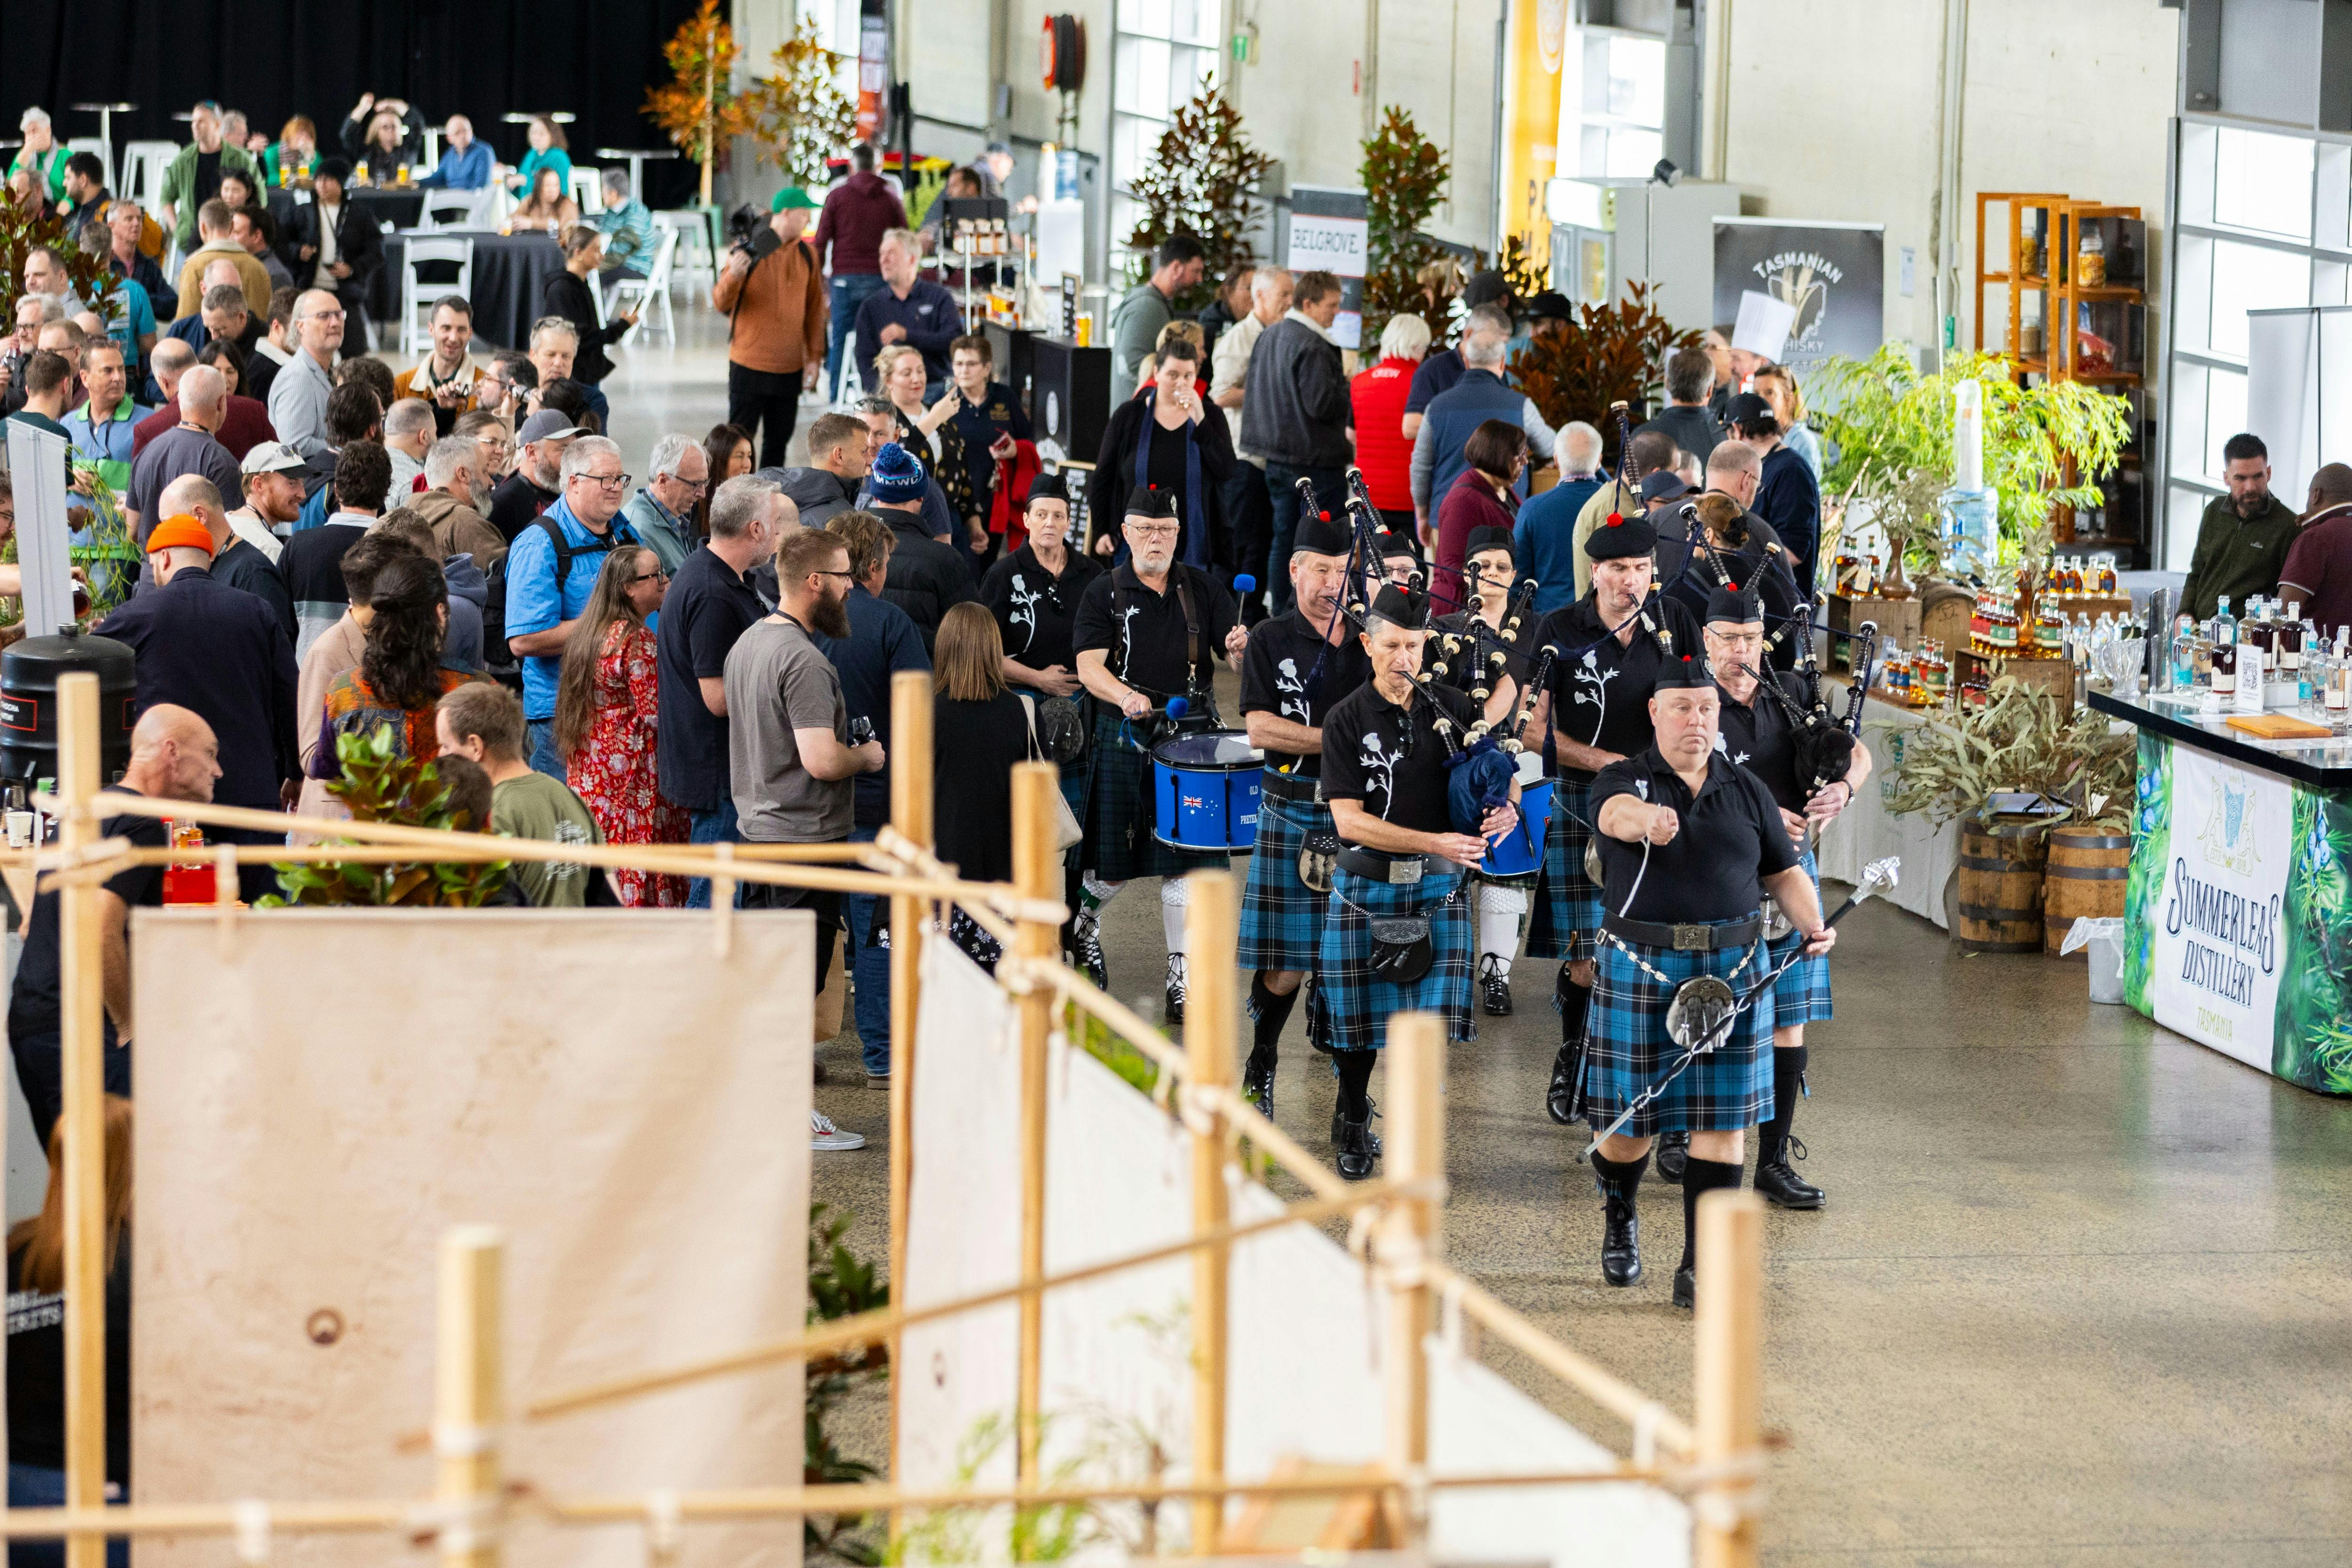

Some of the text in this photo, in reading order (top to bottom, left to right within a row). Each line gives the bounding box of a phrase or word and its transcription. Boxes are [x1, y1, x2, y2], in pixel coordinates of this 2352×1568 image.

[1292, 229, 1359, 254] BELGROVE
[1752, 251, 1843, 284] TASMANIAN
[1784, 341, 1824, 352] HISKY
[1249, 785, 1259, 796] OLD
[2166, 857, 2279, 974] SUMMERLEAS
[2181, 940, 2255, 1007] DISTILLERY
[2197, 1006, 2233, 1043] TASMANIA
